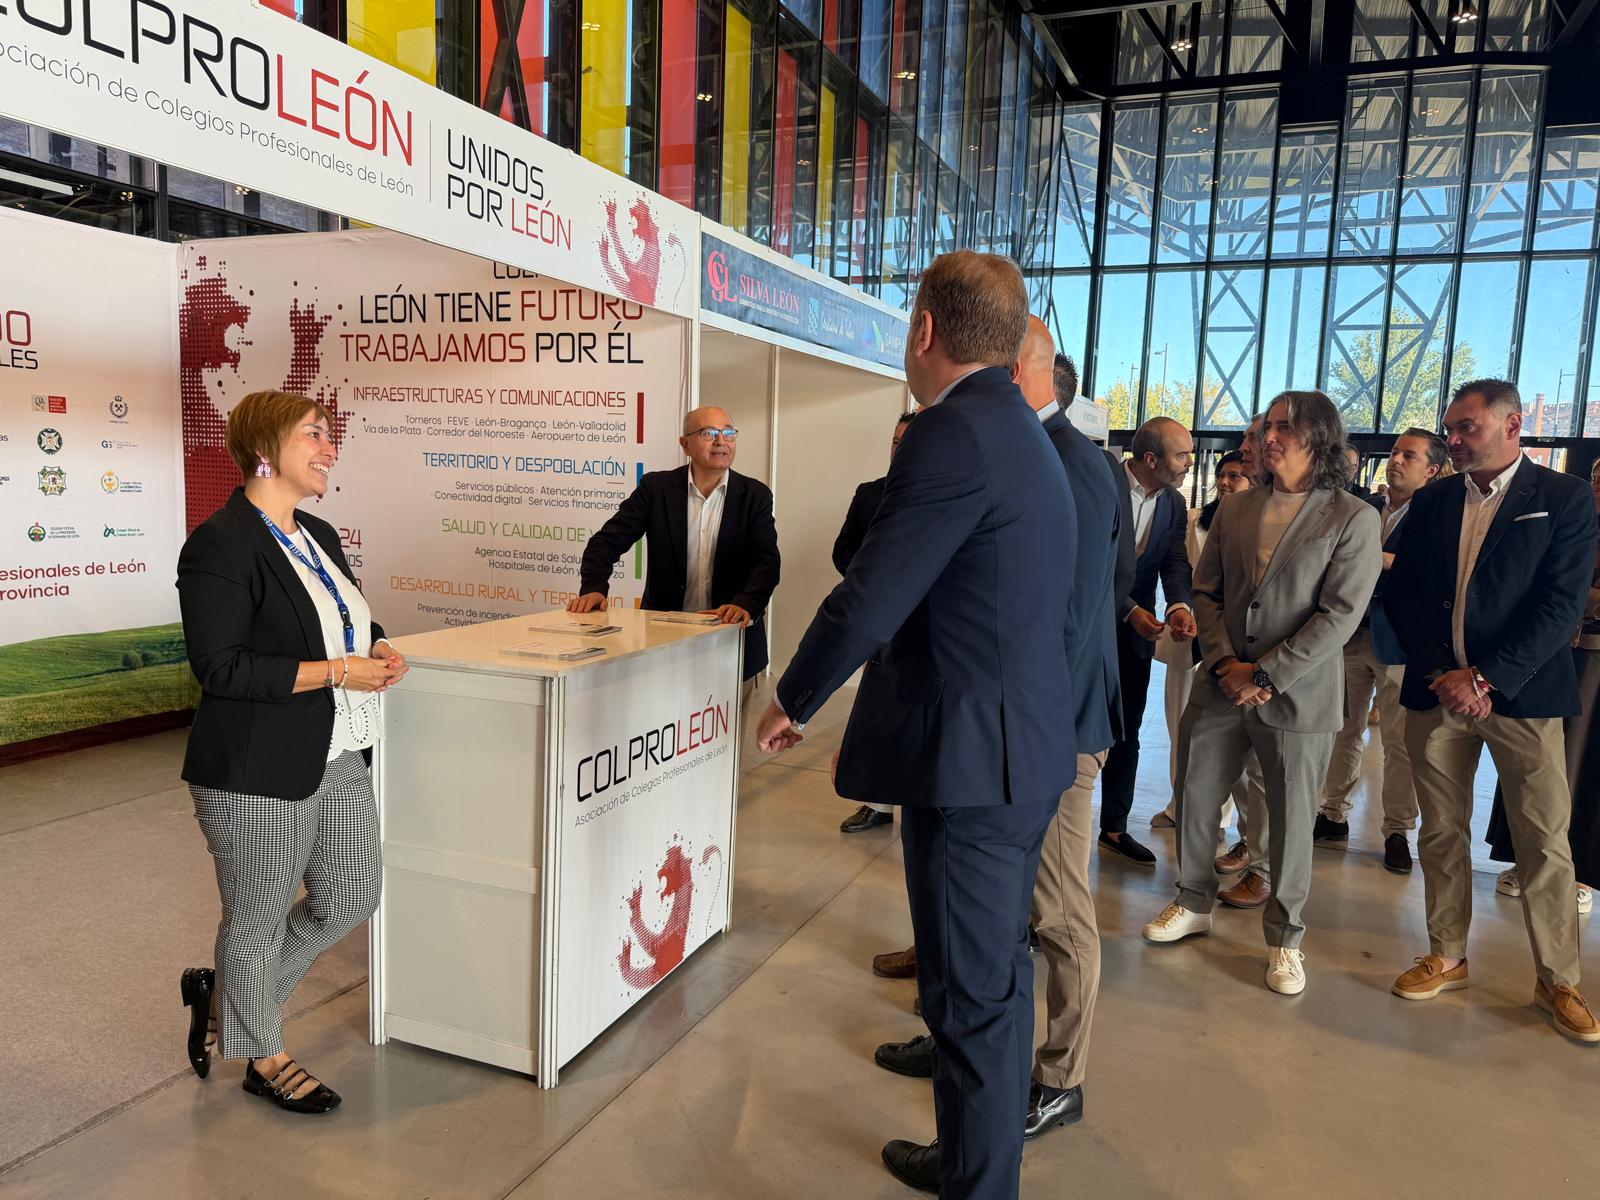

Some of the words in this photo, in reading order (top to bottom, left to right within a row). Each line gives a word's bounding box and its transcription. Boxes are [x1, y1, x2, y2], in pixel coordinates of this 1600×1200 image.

[0, 42, 100, 91] ciación
[108, 77, 138, 103] de
[145, 90, 234, 136] Colegios
[240, 122, 353, 177] Profesionales
[357, 165, 377, 184] de
[380, 172, 414, 197] León
[447, 128, 544, 201] UNIDOS
[447, 173, 504, 228] POR
[511, 198, 572, 251] LEÓN
[360, 283, 427, 324] LEÓN
[434, 291, 511, 323] TIENE
[739, 274, 770, 305] SILVA
[772, 287, 800, 314] LEÓN
[340, 333, 526, 363] TRABAJAMOS
[535, 332, 598, 364] POR
[607, 321, 644, 364] ÉL
[353, 386, 483, 404] INFRAESTRUCTURAS
[486, 389, 497, 405] Y
[500, 389, 626, 408] COMUNICACIONES
[363, 424, 377, 434] Vía
[378, 424, 389, 434] de
[390, 425, 398, 435] la
[400, 425, 422, 435] Plata
[426, 427, 466, 437] Corredor
[468, 428, 483, 438] del
[484, 429, 525, 440] Noroeste
[531, 430, 586, 443] Aeropuerto
[587, 432, 600, 443] de
[602, 433, 626, 444] León
[405, 415, 442, 425] Torneros
[447, 416, 469, 426] FEVE
[552, 420, 626, 432] León-Valladolid
[422, 452, 498, 470] TERRITORIO
[502, 455, 512, 471] Y
[515, 456, 626, 476] DESPOBLACIÓN
[434, 490, 493, 503] Conectividad
[494, 494, 523, 506] digital
[528, 496, 570, 508] Servicios
[572, 498, 620, 511] financiero
[455, 480, 494, 492] Servicios
[496, 482, 535, 494] públicos
[540, 485, 582, 497] Atención
[583, 488, 626, 500] primaria
[441, 518, 486, 535] SALUD
[489, 521, 499, 536] Y
[502, 522, 563, 541] CALIDAD
[566, 527, 586, 543] DE
[84, 561, 105, 576] de
[109, 558, 146, 574] León
[474, 547, 511, 559] Agencia
[513, 549, 545, 561] Estatal
[547, 552, 560, 563] de
[561, 553, 581, 565] Salu
[488, 559, 536, 571] Hospitales
[537, 562, 550, 573] de
[551, 564, 575, 575] León
[390, 575, 475, 597] DESARROLLO
[478, 583, 525, 602] RURAL
[528, 588, 538, 603] Y
[417, 603, 464, 617] Prevención
[466, 607, 478, 618] de
[577, 694, 729, 803] COLPROLEÓN
[575, 795, 619, 828] Asociación
[619, 791, 631, 805] de
[631, 775, 661, 798] Colegios
[662, 757, 704, 782] Profesionales
[705, 753, 713, 762] de
[713, 744, 728, 758] León
